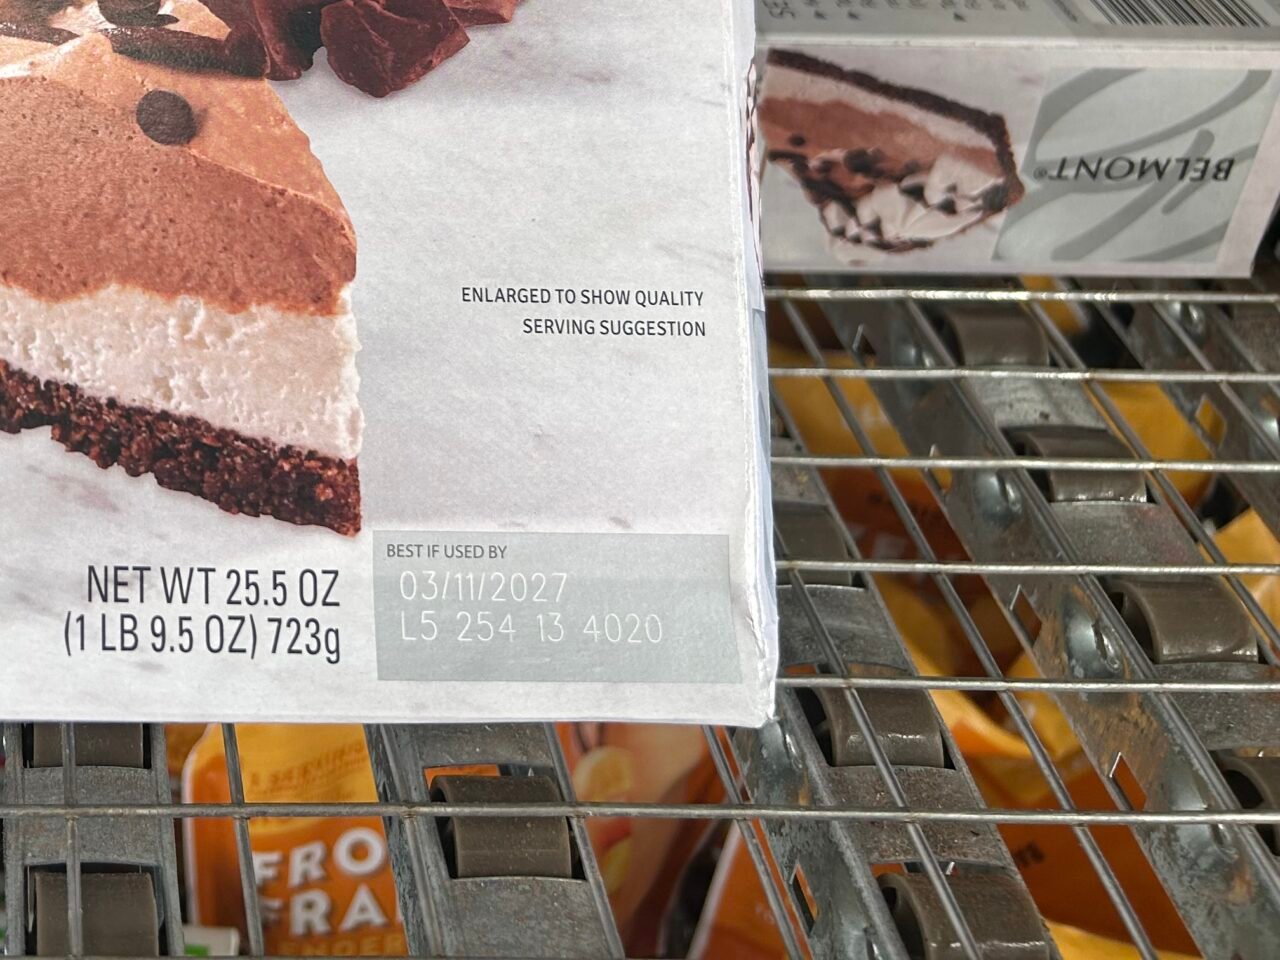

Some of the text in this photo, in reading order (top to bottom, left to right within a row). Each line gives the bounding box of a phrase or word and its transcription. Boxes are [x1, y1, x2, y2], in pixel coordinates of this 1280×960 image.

[461, 287, 704, 308] ENLARGED TO SHOW QUALITY
[522, 318, 706, 337] SERVING SUGGESTION
[386, 543, 507, 559] BEST IF USED BY
[87, 565, 341, 607] NET WT 25.5 OZ
[400, 570, 568, 602] 03/11/2027
[64, 611, 341, 664] (1 LB 9.5 OZ) 723g
[400, 610, 663, 643] L5 254 13 4020
[252, 826, 387, 889] FRO
